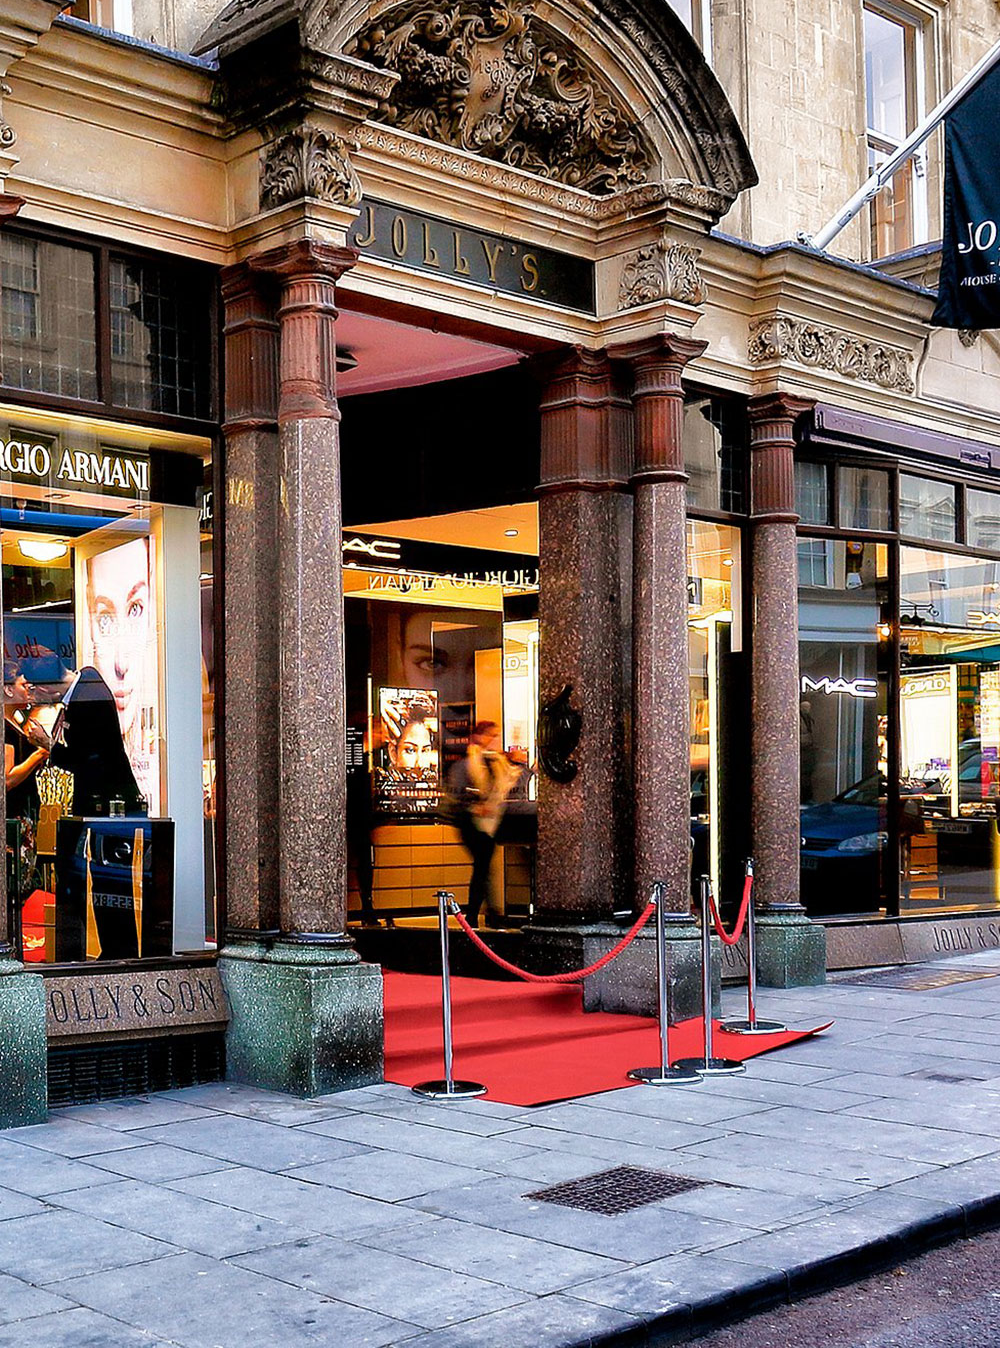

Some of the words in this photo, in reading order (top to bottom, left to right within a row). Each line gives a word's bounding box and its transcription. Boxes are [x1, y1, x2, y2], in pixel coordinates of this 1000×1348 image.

[957, 220, 1000, 254] JO
[56, 448, 150, 491] ARMANI
[341, 537, 401, 560] AC
[933, 926, 973, 953] JOLLY
[976, 925, 988, 949] &
[988, 922, 1000, 947] S
[721, 940, 749, 969] ON
[49, 984, 122, 1023] OLLY
[132, 983, 150, 1018] &
[155, 977, 218, 1014] SON
